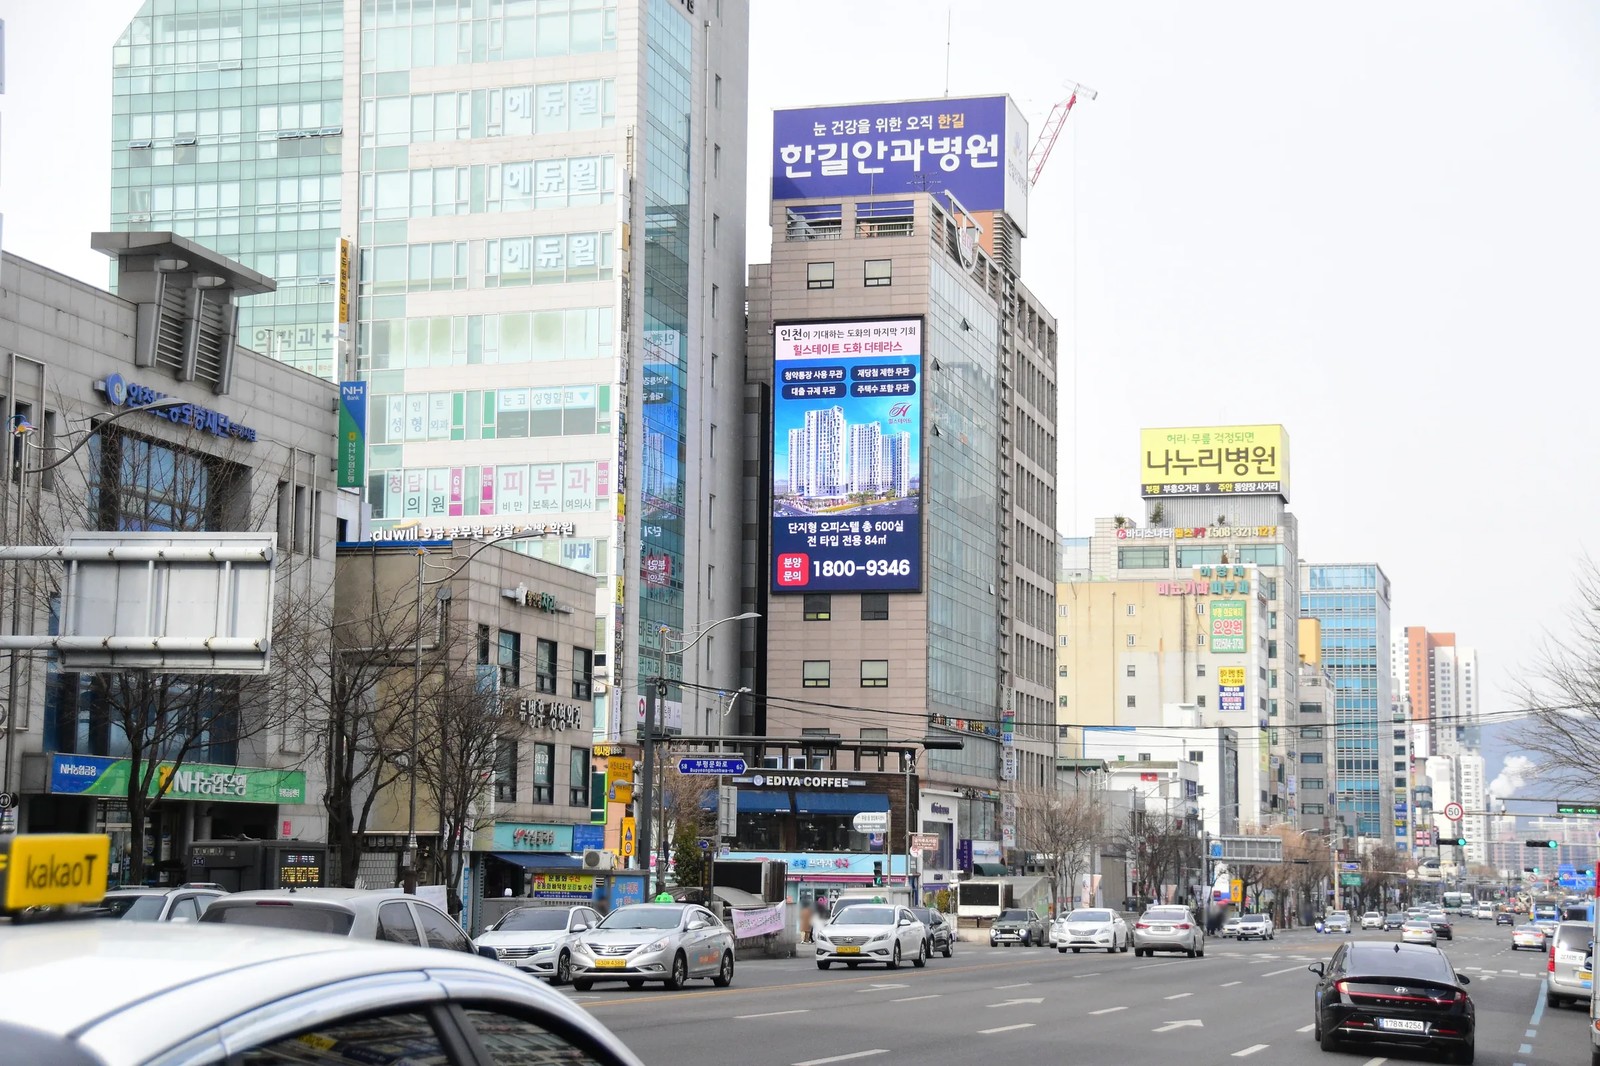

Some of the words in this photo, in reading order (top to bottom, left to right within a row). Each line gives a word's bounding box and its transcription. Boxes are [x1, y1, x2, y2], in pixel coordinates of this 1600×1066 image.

[508, 85, 598, 119] 에듀윌
[813, 121, 827, 136] 눈
[831, 119, 871, 136] 건강을
[875, 117, 903, 132] 위한
[906, 115, 933, 130] 오직
[937, 113, 965, 129] 한길
[780, 134, 999, 178] 한길안과병원
[506, 161, 597, 194] 에듀윌
[505, 236, 596, 270] 에듀윌
[780, 328, 811, 342] 인천이
[813, 329, 845, 339] 기대하는
[847, 328, 871, 338] 도화의
[873, 328, 897, 337] 마지막
[900, 327, 916, 336] 기회
[793, 343, 841, 356] 힐스테이트
[843, 342, 862, 353] 도화
[864, 341, 903, 353] 더테라스
[784, 370, 812, 381] 청약통장
[813, 370, 827, 379] 사용
[828, 369, 843, 379] 무관
[857, 368, 880, 377] 재당첨
[880, 367, 894, 377] 제한
[895, 367, 910, 376] 무관
[343, 386, 363, 395] NH
[791, 387, 805, 396] 대출
[806, 387, 821, 396] 규제
[822, 386, 836, 395] 무관
[857, 385, 878, 394] 주택수
[879, 384, 894, 393] 포함
[895, 384, 910, 393] 무관
[1214, 432, 1255, 444] 걱정되면
[1147, 446, 1276, 476] 나누리병원
[502, 468, 591, 497] 피부과
[1145, 484, 1160, 494] 부평
[1163, 483, 1200, 493] 부흥오거리
[1218, 483, 1233, 492] 주안
[407, 495, 445, 514] 의원
[502, 501, 523, 512] 비만
[531, 499, 559, 511] 보톡스
[565, 499, 592, 509] 여의사
[551, 521, 575, 535] 학원
[788, 521, 817, 534] 단지형
[820, 521, 860, 534] 오피스텔
[861, 521, 873, 532] 총
[875, 520, 904, 532] 600실
[807, 536, 817, 547] 전
[820, 535, 839, 547] 타입
[842, 535, 862, 547] 전용
[564, 542, 592, 560] 내과
[783, 557, 802, 569] 분양
[813, 559, 910, 577] 1800-9346
[783, 571, 802, 581] 문의
[1213, 620, 1243, 635] 요양원
[549, 702, 582, 731] 성형외과
[59, 763, 97, 777] NH농협금융
[696, 760, 728, 768] 부평문화로
[173, 770, 248, 797] NH농협은행
[766, 775, 801, 786] EDIYA
[803, 776, 849, 787] COFFEE
[1448, 808, 1460, 816] 50
